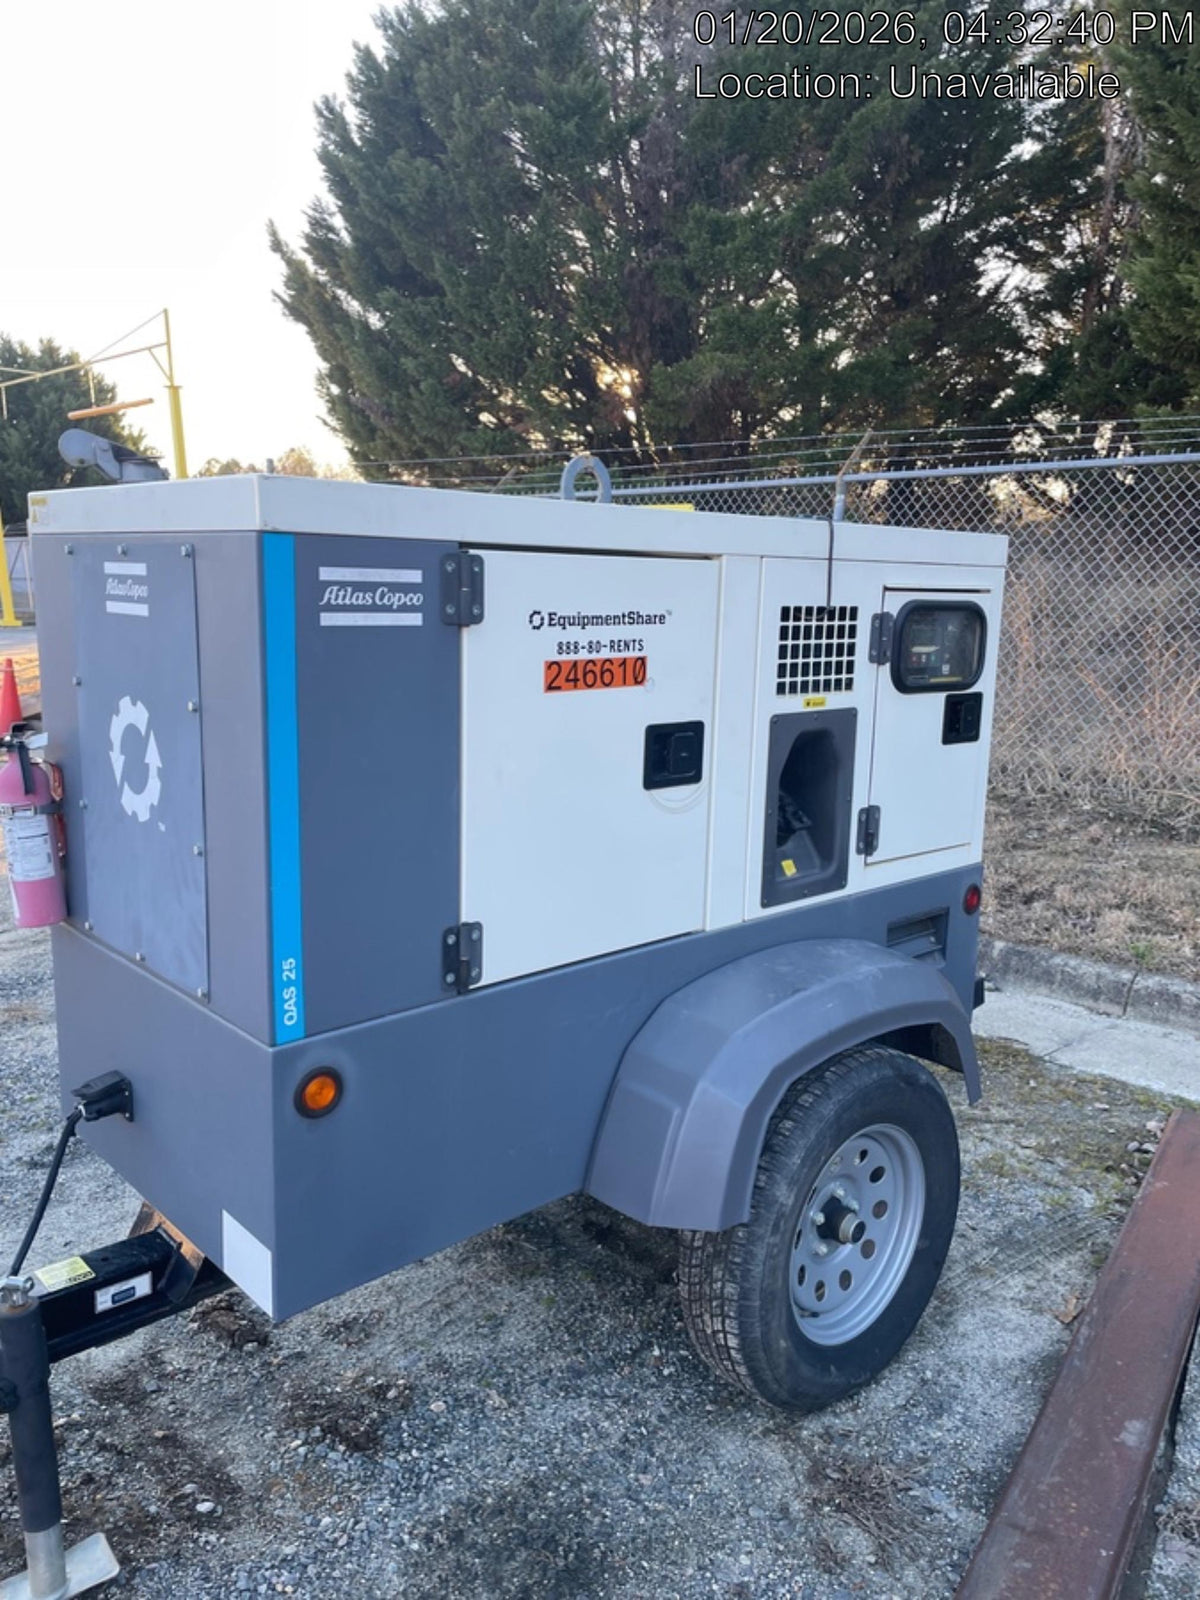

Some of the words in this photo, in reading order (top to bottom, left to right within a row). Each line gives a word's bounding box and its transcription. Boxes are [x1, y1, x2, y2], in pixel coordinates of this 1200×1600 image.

[556, 639, 645, 655] 888-80-RENTS
[546, 656, 647, 691] 246610
[282, 957, 296, 982] 25
[283, 986, 298, 1026] QAS
